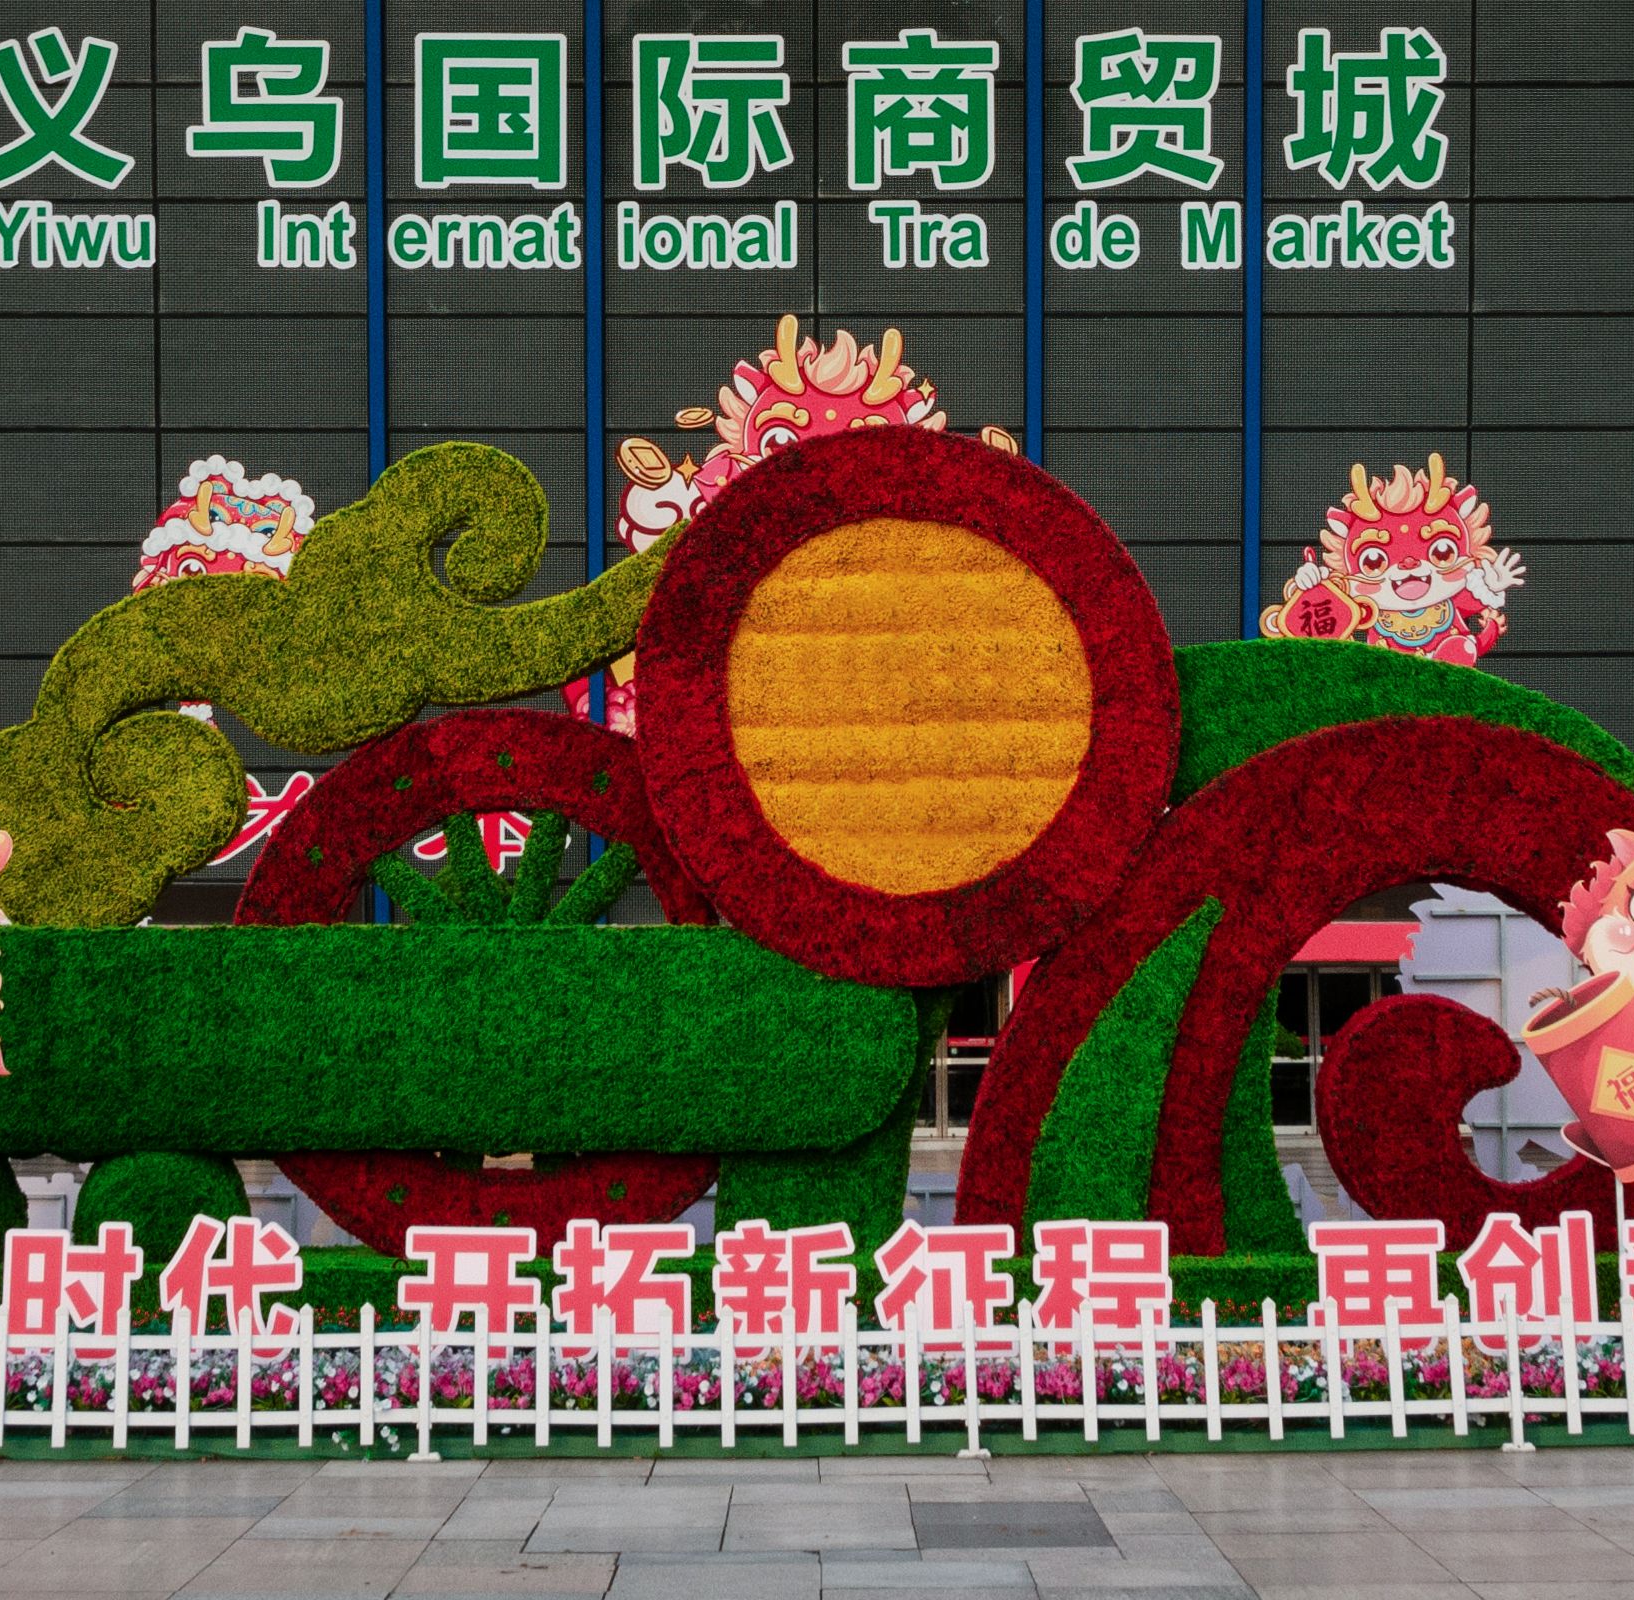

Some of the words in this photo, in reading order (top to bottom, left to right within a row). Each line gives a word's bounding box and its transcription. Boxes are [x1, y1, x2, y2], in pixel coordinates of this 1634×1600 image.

[1299, 599, 1337, 637] 福
[397, 1219, 1172, 1363] 开拓新征程
